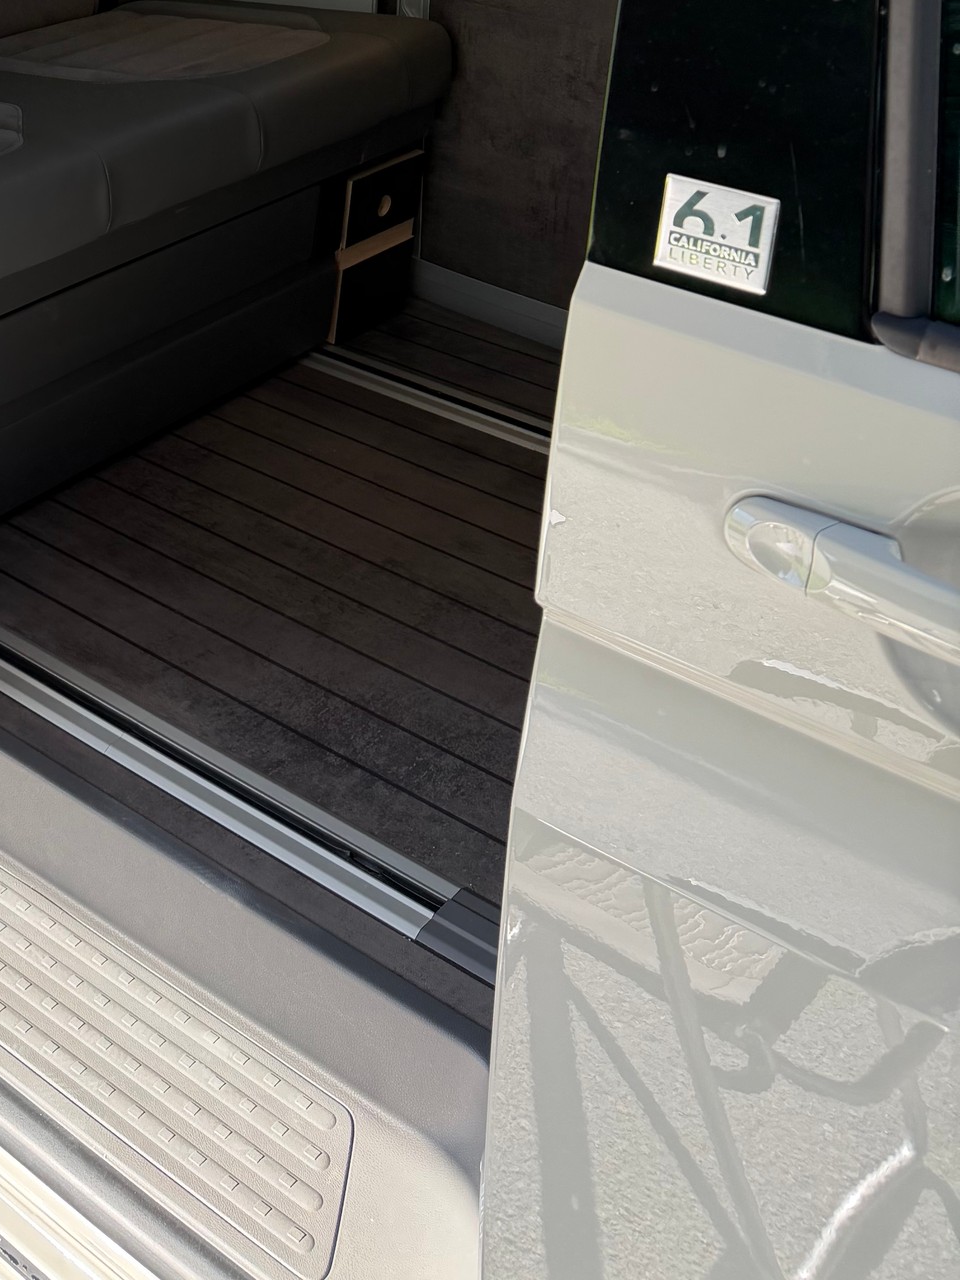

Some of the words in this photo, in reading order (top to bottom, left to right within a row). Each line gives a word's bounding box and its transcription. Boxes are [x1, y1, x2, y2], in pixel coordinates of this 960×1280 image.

[673, 190, 765, 249] 6.1
[669, 232, 757, 267] CALIFORNIA
[669, 248, 755, 280] LIBERTY
